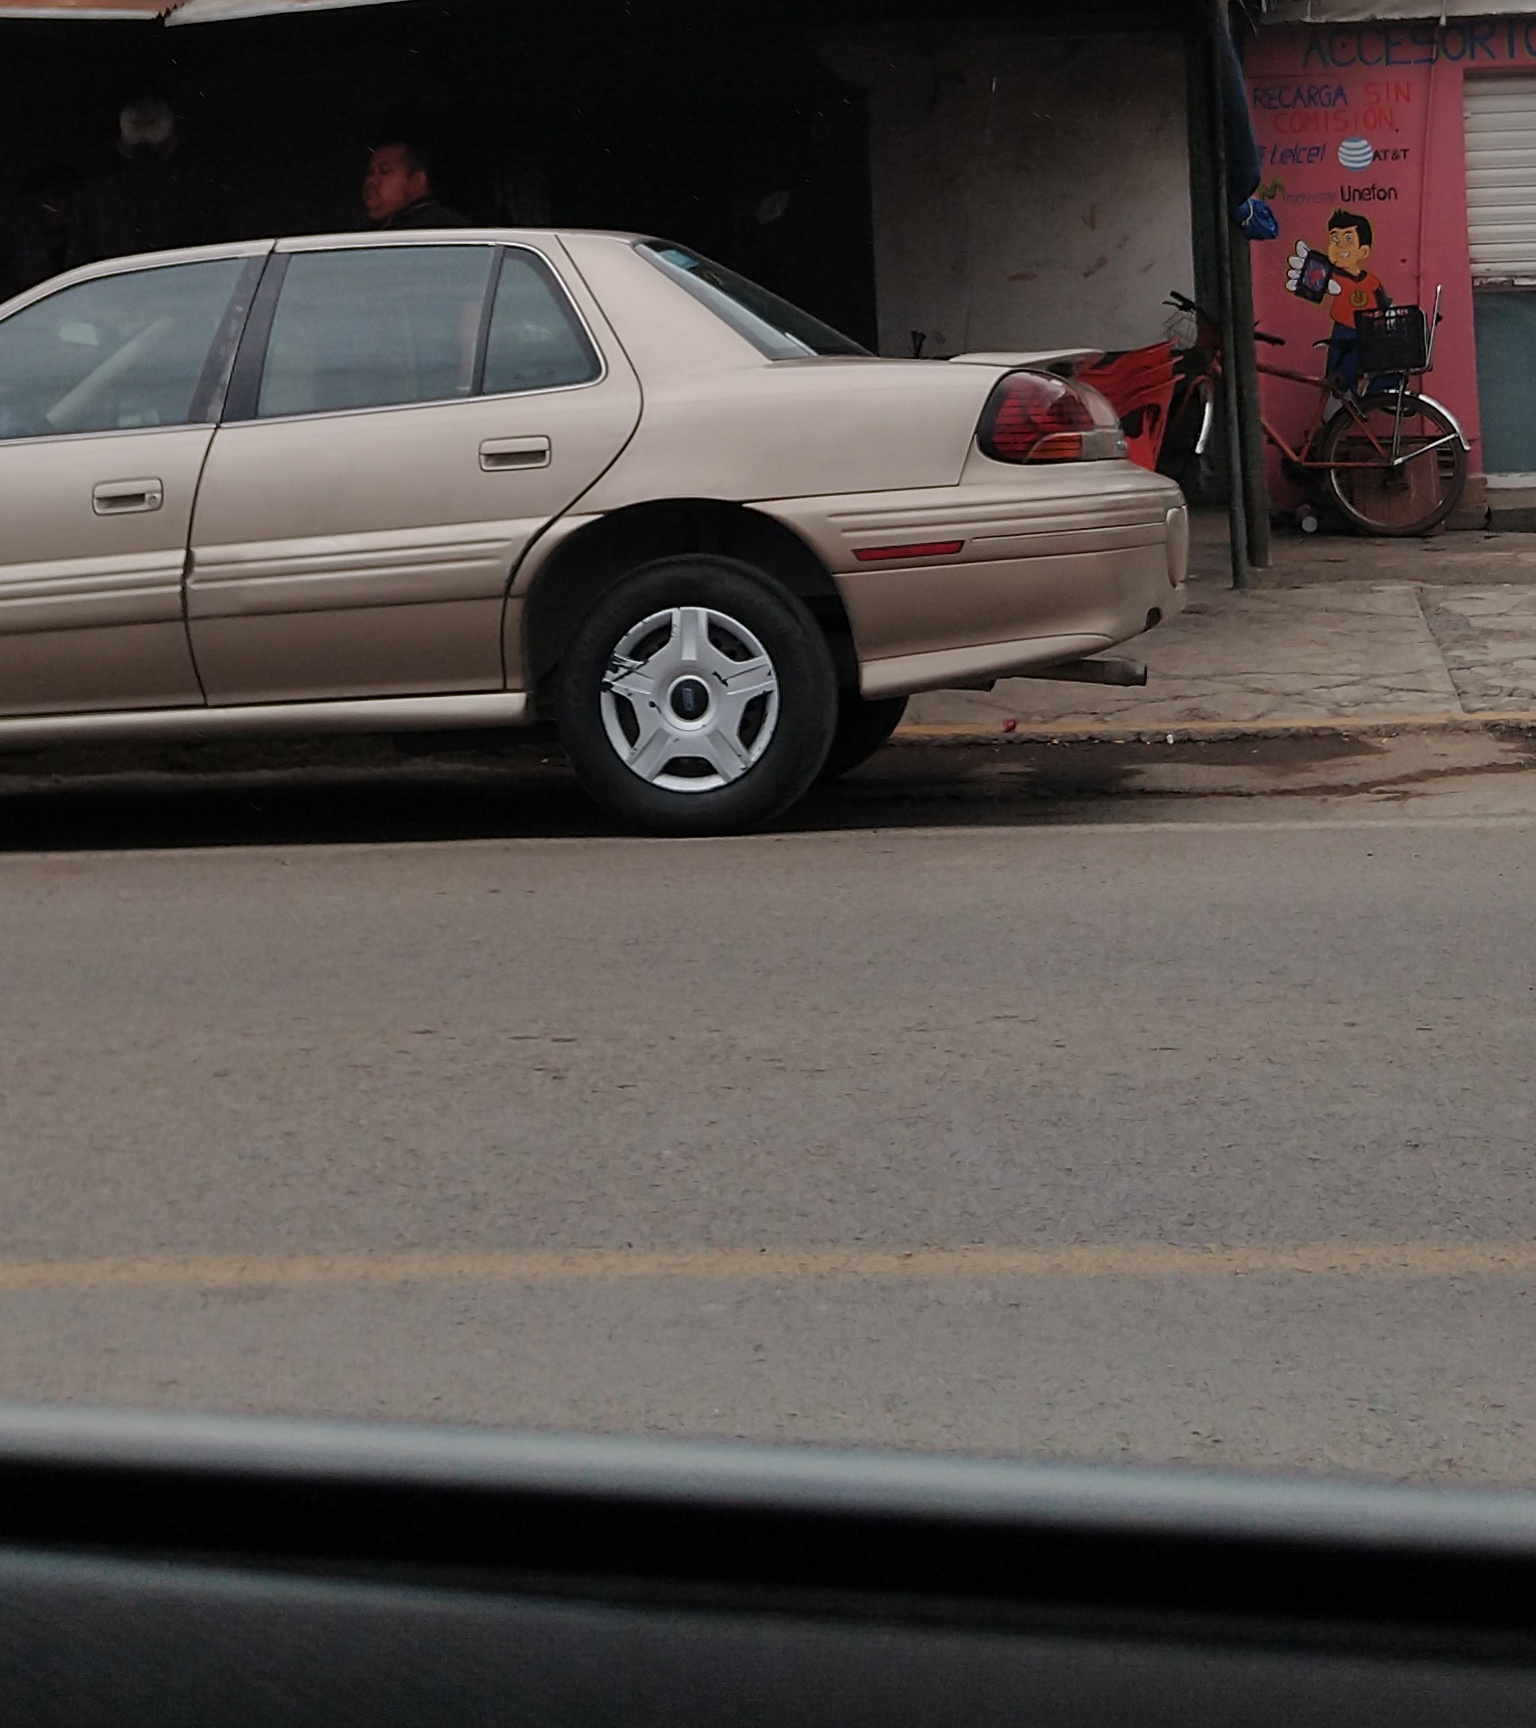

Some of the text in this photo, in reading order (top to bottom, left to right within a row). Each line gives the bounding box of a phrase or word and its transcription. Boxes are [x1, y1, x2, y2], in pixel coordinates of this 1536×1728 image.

[1252, 80, 1411, 110] RECARGA SIN
[1371, 148, 1411, 162] AT&T
[1339, 183, 1399, 203] Unefon
